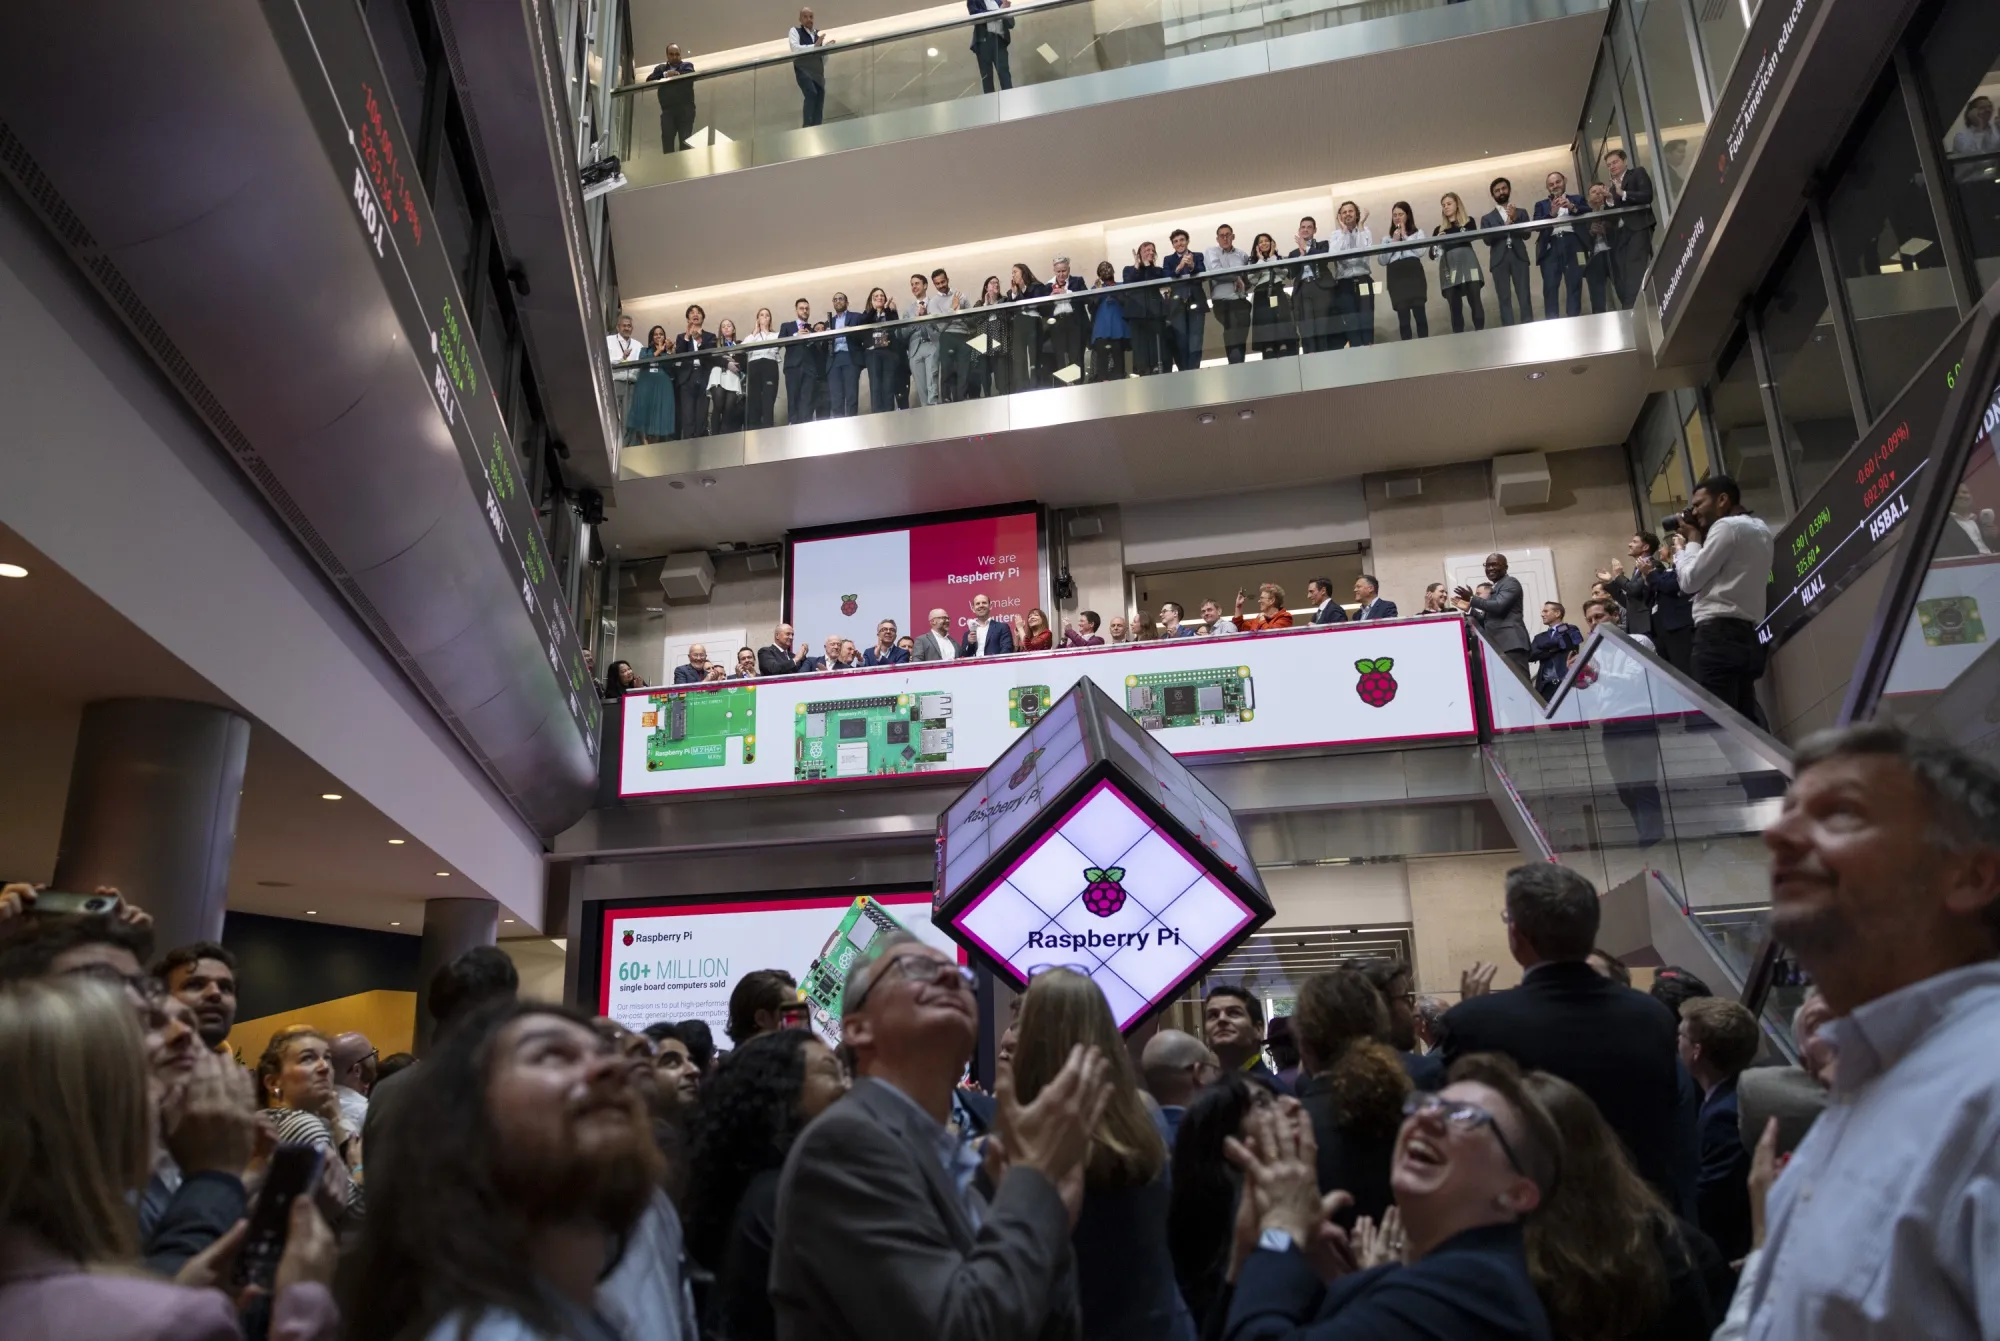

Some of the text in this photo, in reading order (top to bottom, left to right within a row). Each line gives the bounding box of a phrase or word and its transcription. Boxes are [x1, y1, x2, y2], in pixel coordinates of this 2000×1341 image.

[1728, 127, 1744, 161] Four
[1744, 48, 1779, 130] American
[354, 168, 383, 258] RIO.L
[1662, 264, 1683, 311] absolute
[1681, 216, 1704, 268] majority
[1855, 421, 1910, 485] -0.60 (-0.09%)
[1863, 473, 1889, 509] 692.90
[1869, 494, 1909, 542] HSBA.L
[977, 554, 1017, 566] We are
[1796, 548, 1816, 578] 325.60
[947, 567, 1020, 584] Raspberry Pi
[990, 596, 1021, 608] make
[1801, 574, 1826, 607] HLN.L
[655, 747, 683, 757] Raspberry
[684, 747, 691, 755] Pi
[964, 786, 1044, 825] Raspberry Pi
[636, 931, 692, 944] Raspberry Pi
[1028, 927, 1180, 952] Raspberry Pi
[619, 957, 729, 981] 60+ MILLION
[620, 979, 726, 993] single board computers sold
[630, 1002, 654, 1010] mission
[669, 1002, 680, 1010] put
[680, 1000, 729, 1009] high-performan
[645, 1011, 695, 1019] general-purpose
[696, 1009, 729, 1018] computing
